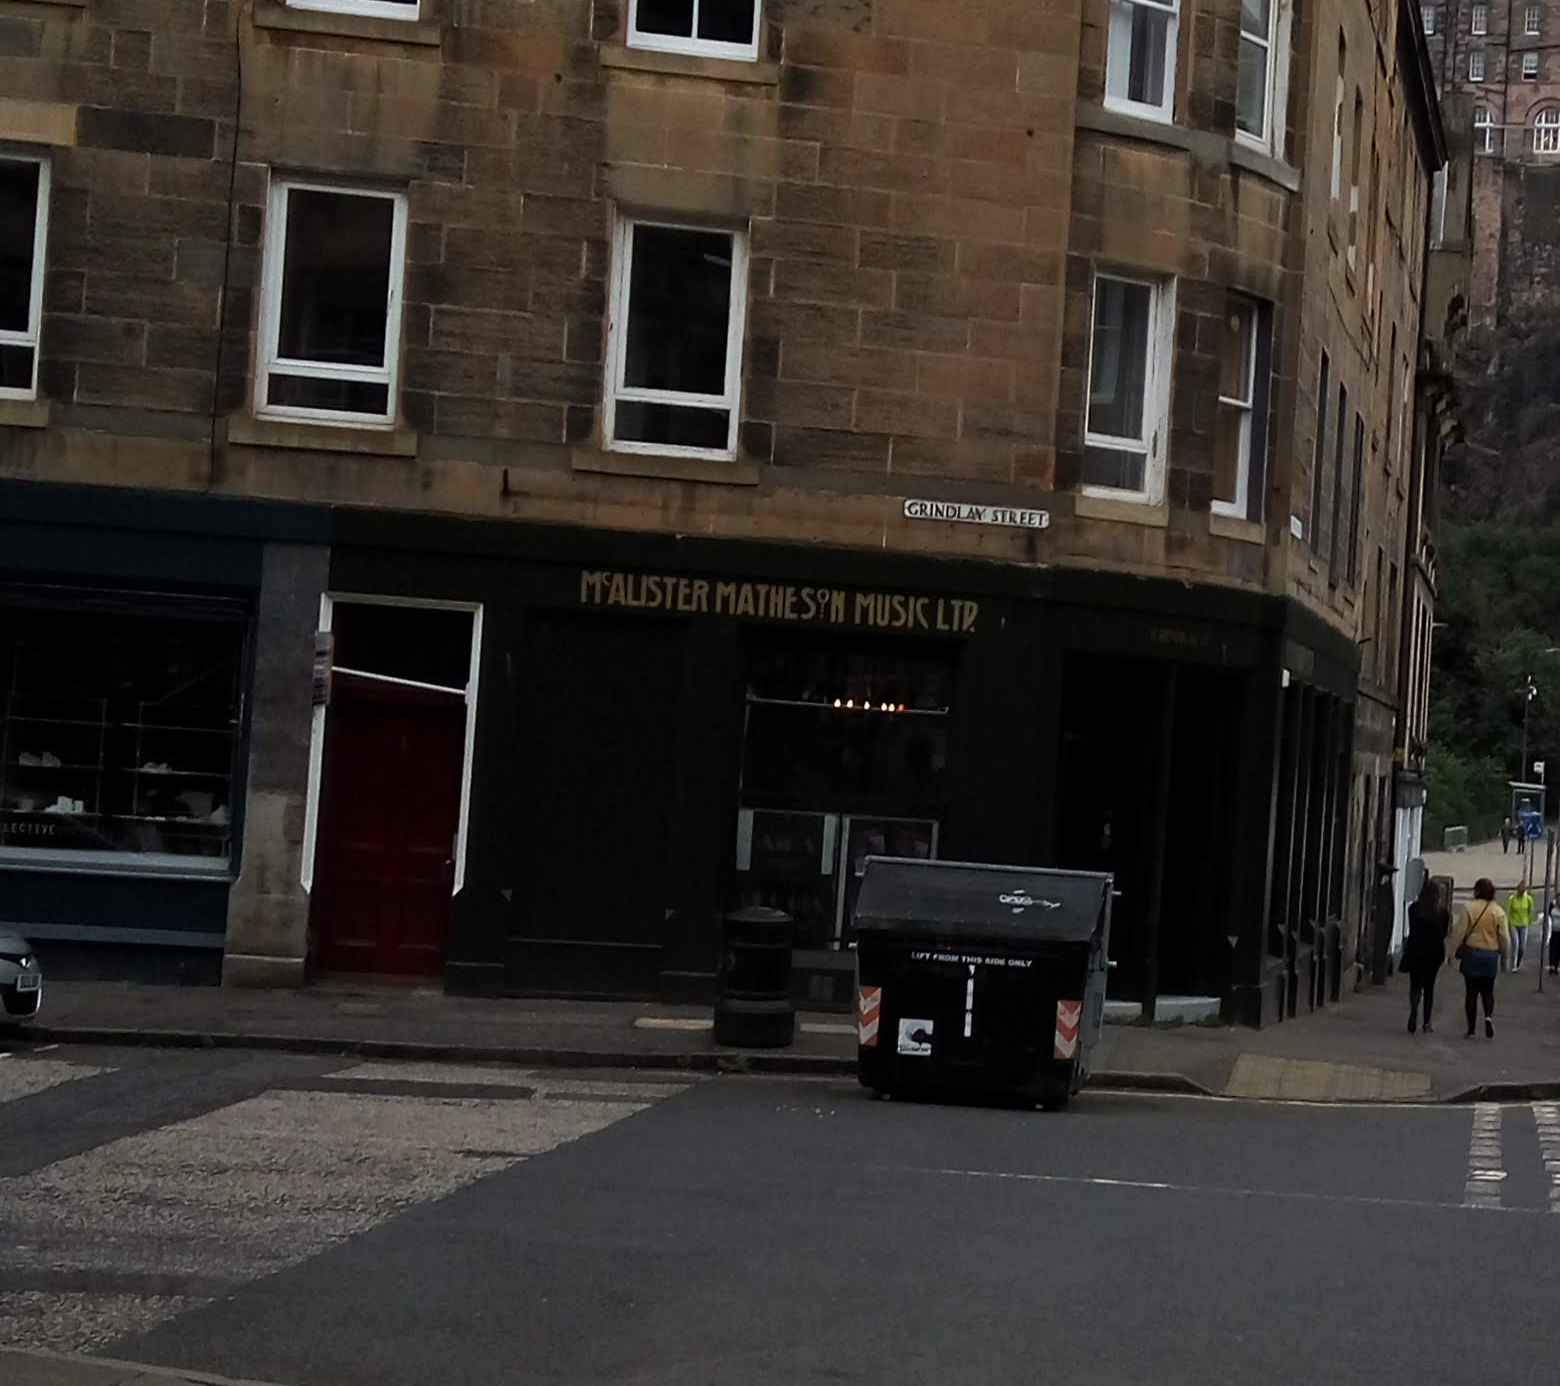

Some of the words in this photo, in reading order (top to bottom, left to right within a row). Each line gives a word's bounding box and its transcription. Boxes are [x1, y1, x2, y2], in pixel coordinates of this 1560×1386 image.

[907, 501, 986, 521] GRINDLAY
[992, 509, 1047, 526] STREET
[854, 592, 929, 629] MUSIC
[0, 821, 56, 836] LECTIVE
[932, 953, 959, 963] FROM
[961, 955, 983, 964] THIS
[1008, 959, 1033, 968] ONLY
